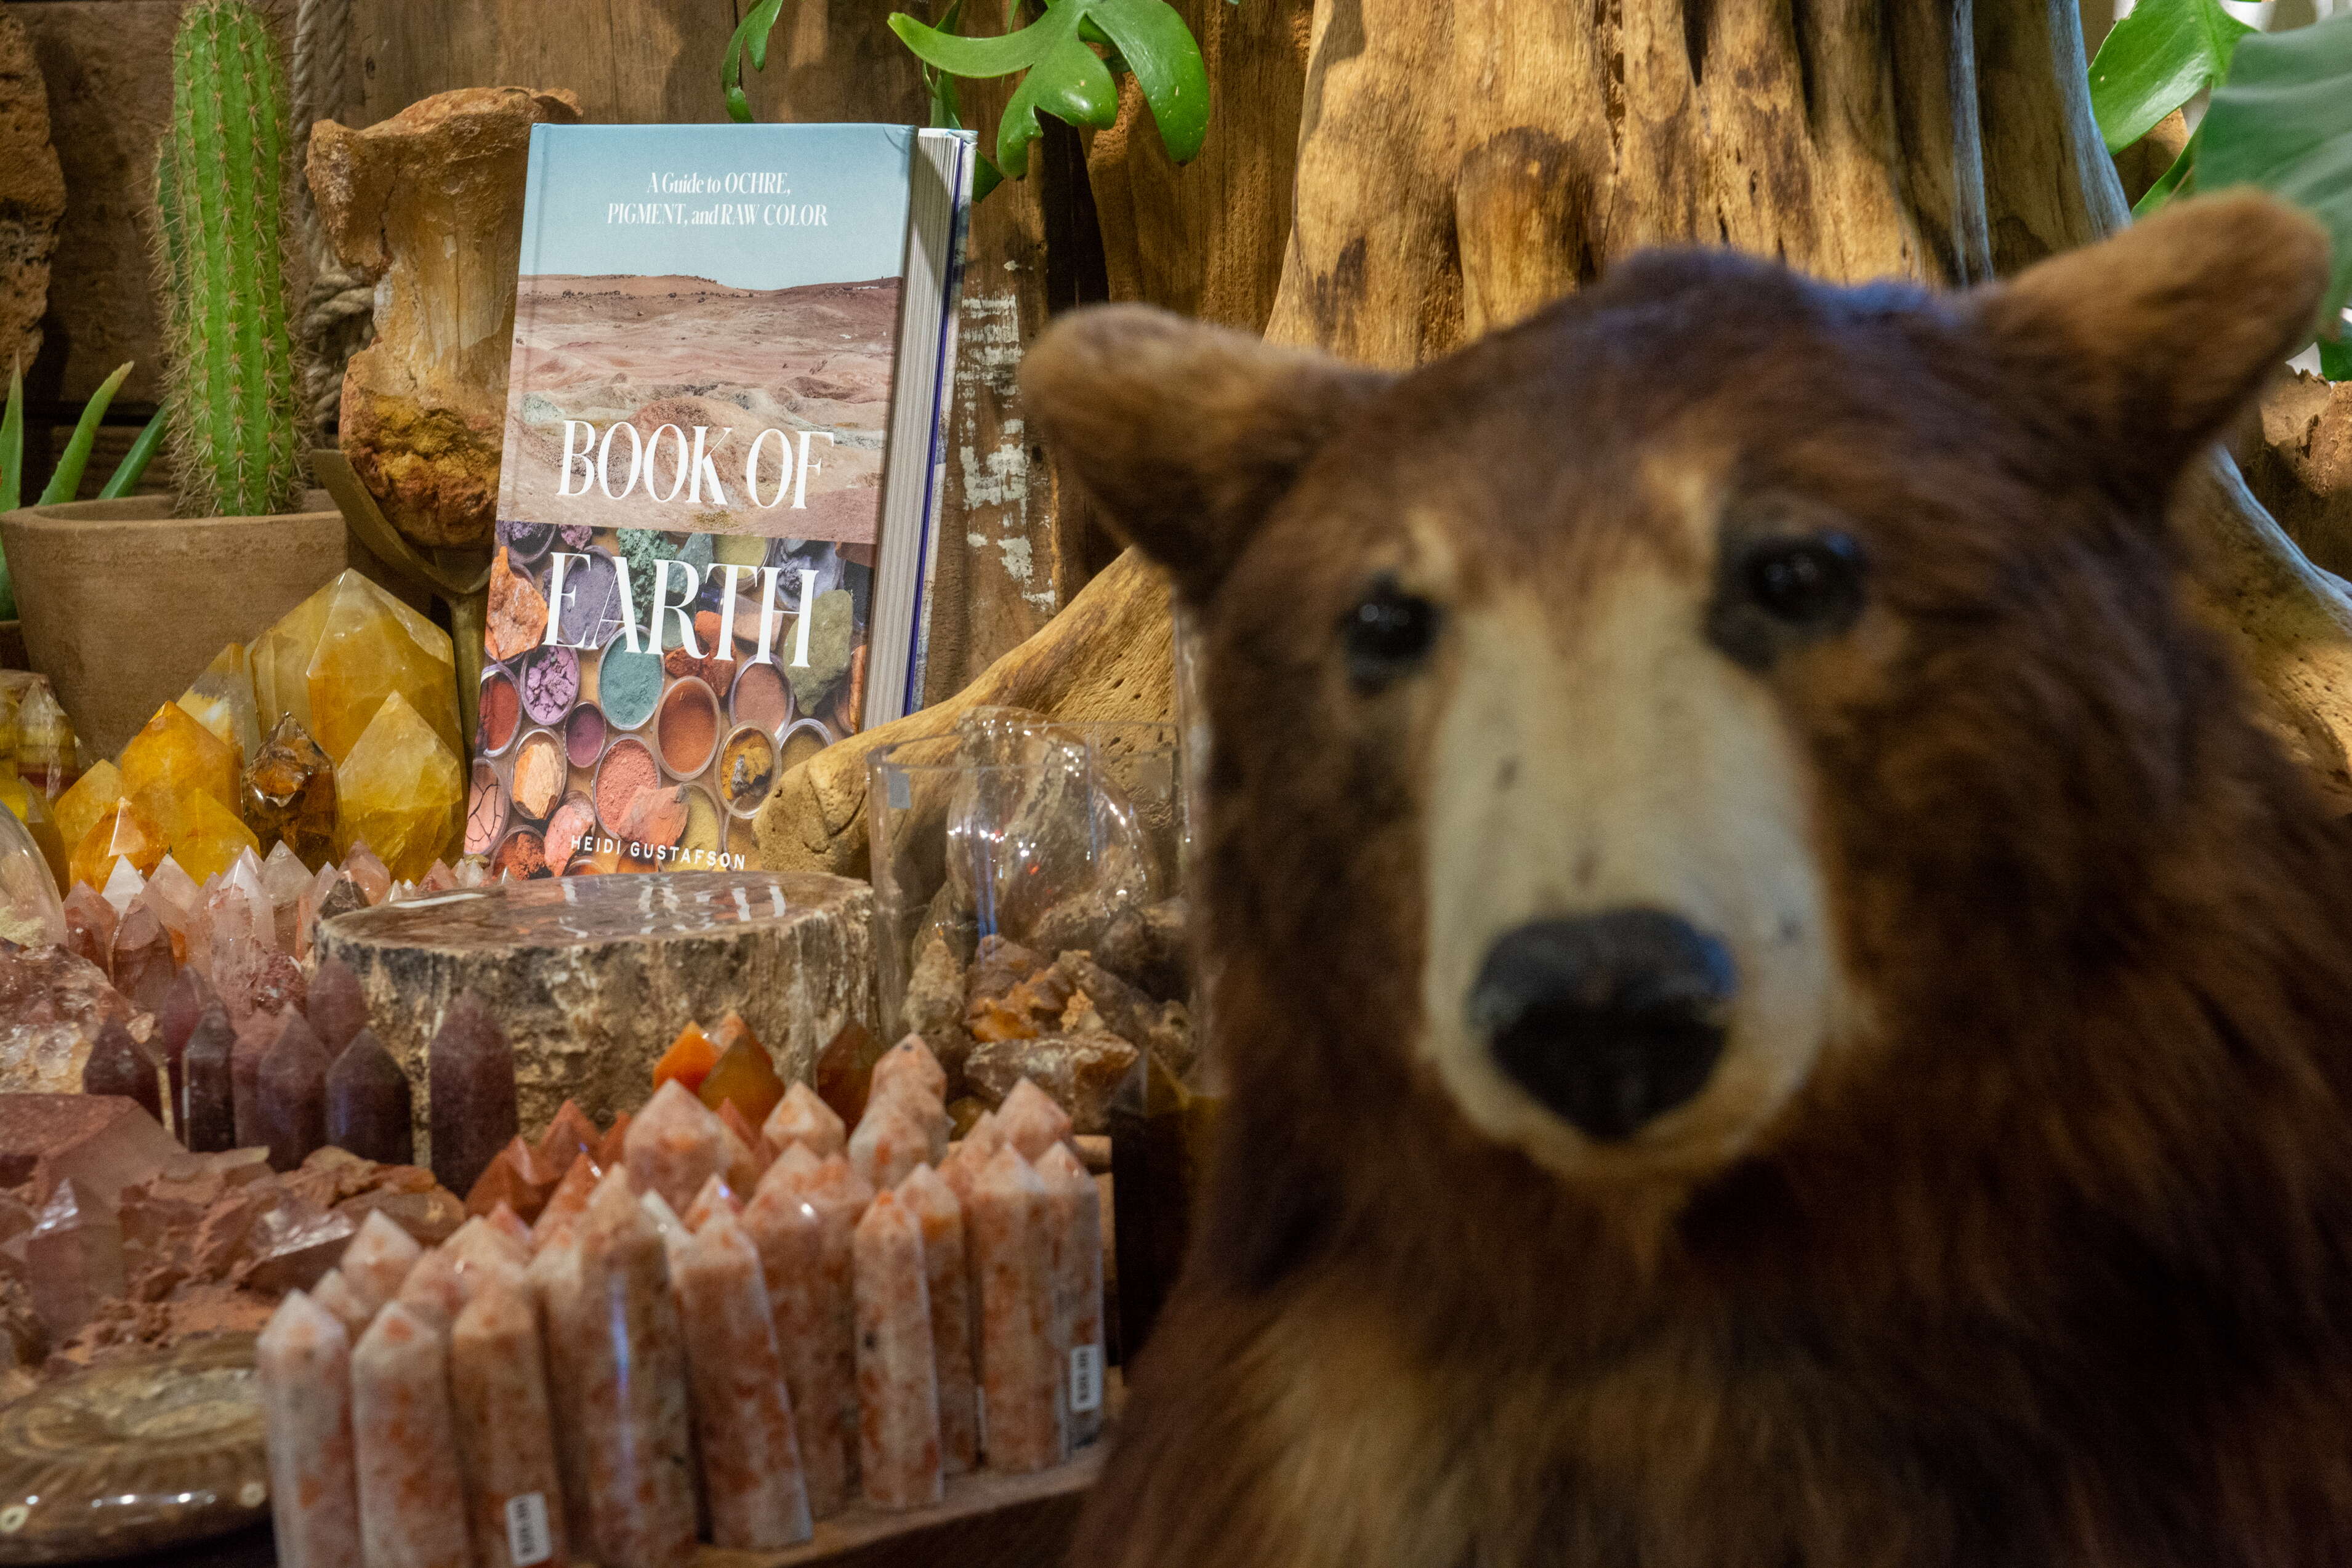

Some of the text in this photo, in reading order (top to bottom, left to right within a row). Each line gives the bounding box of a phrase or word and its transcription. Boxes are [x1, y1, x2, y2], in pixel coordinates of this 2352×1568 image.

[646, 172, 791, 196] A Guide to OCHRE,
[607, 203, 828, 227] PIGMENT, and RAW COLOR
[556, 420, 835, 509] BOOK OF
[541, 552, 820, 667] EARTH
[571, 835, 746, 870] HEIDI GUSTAFSON
